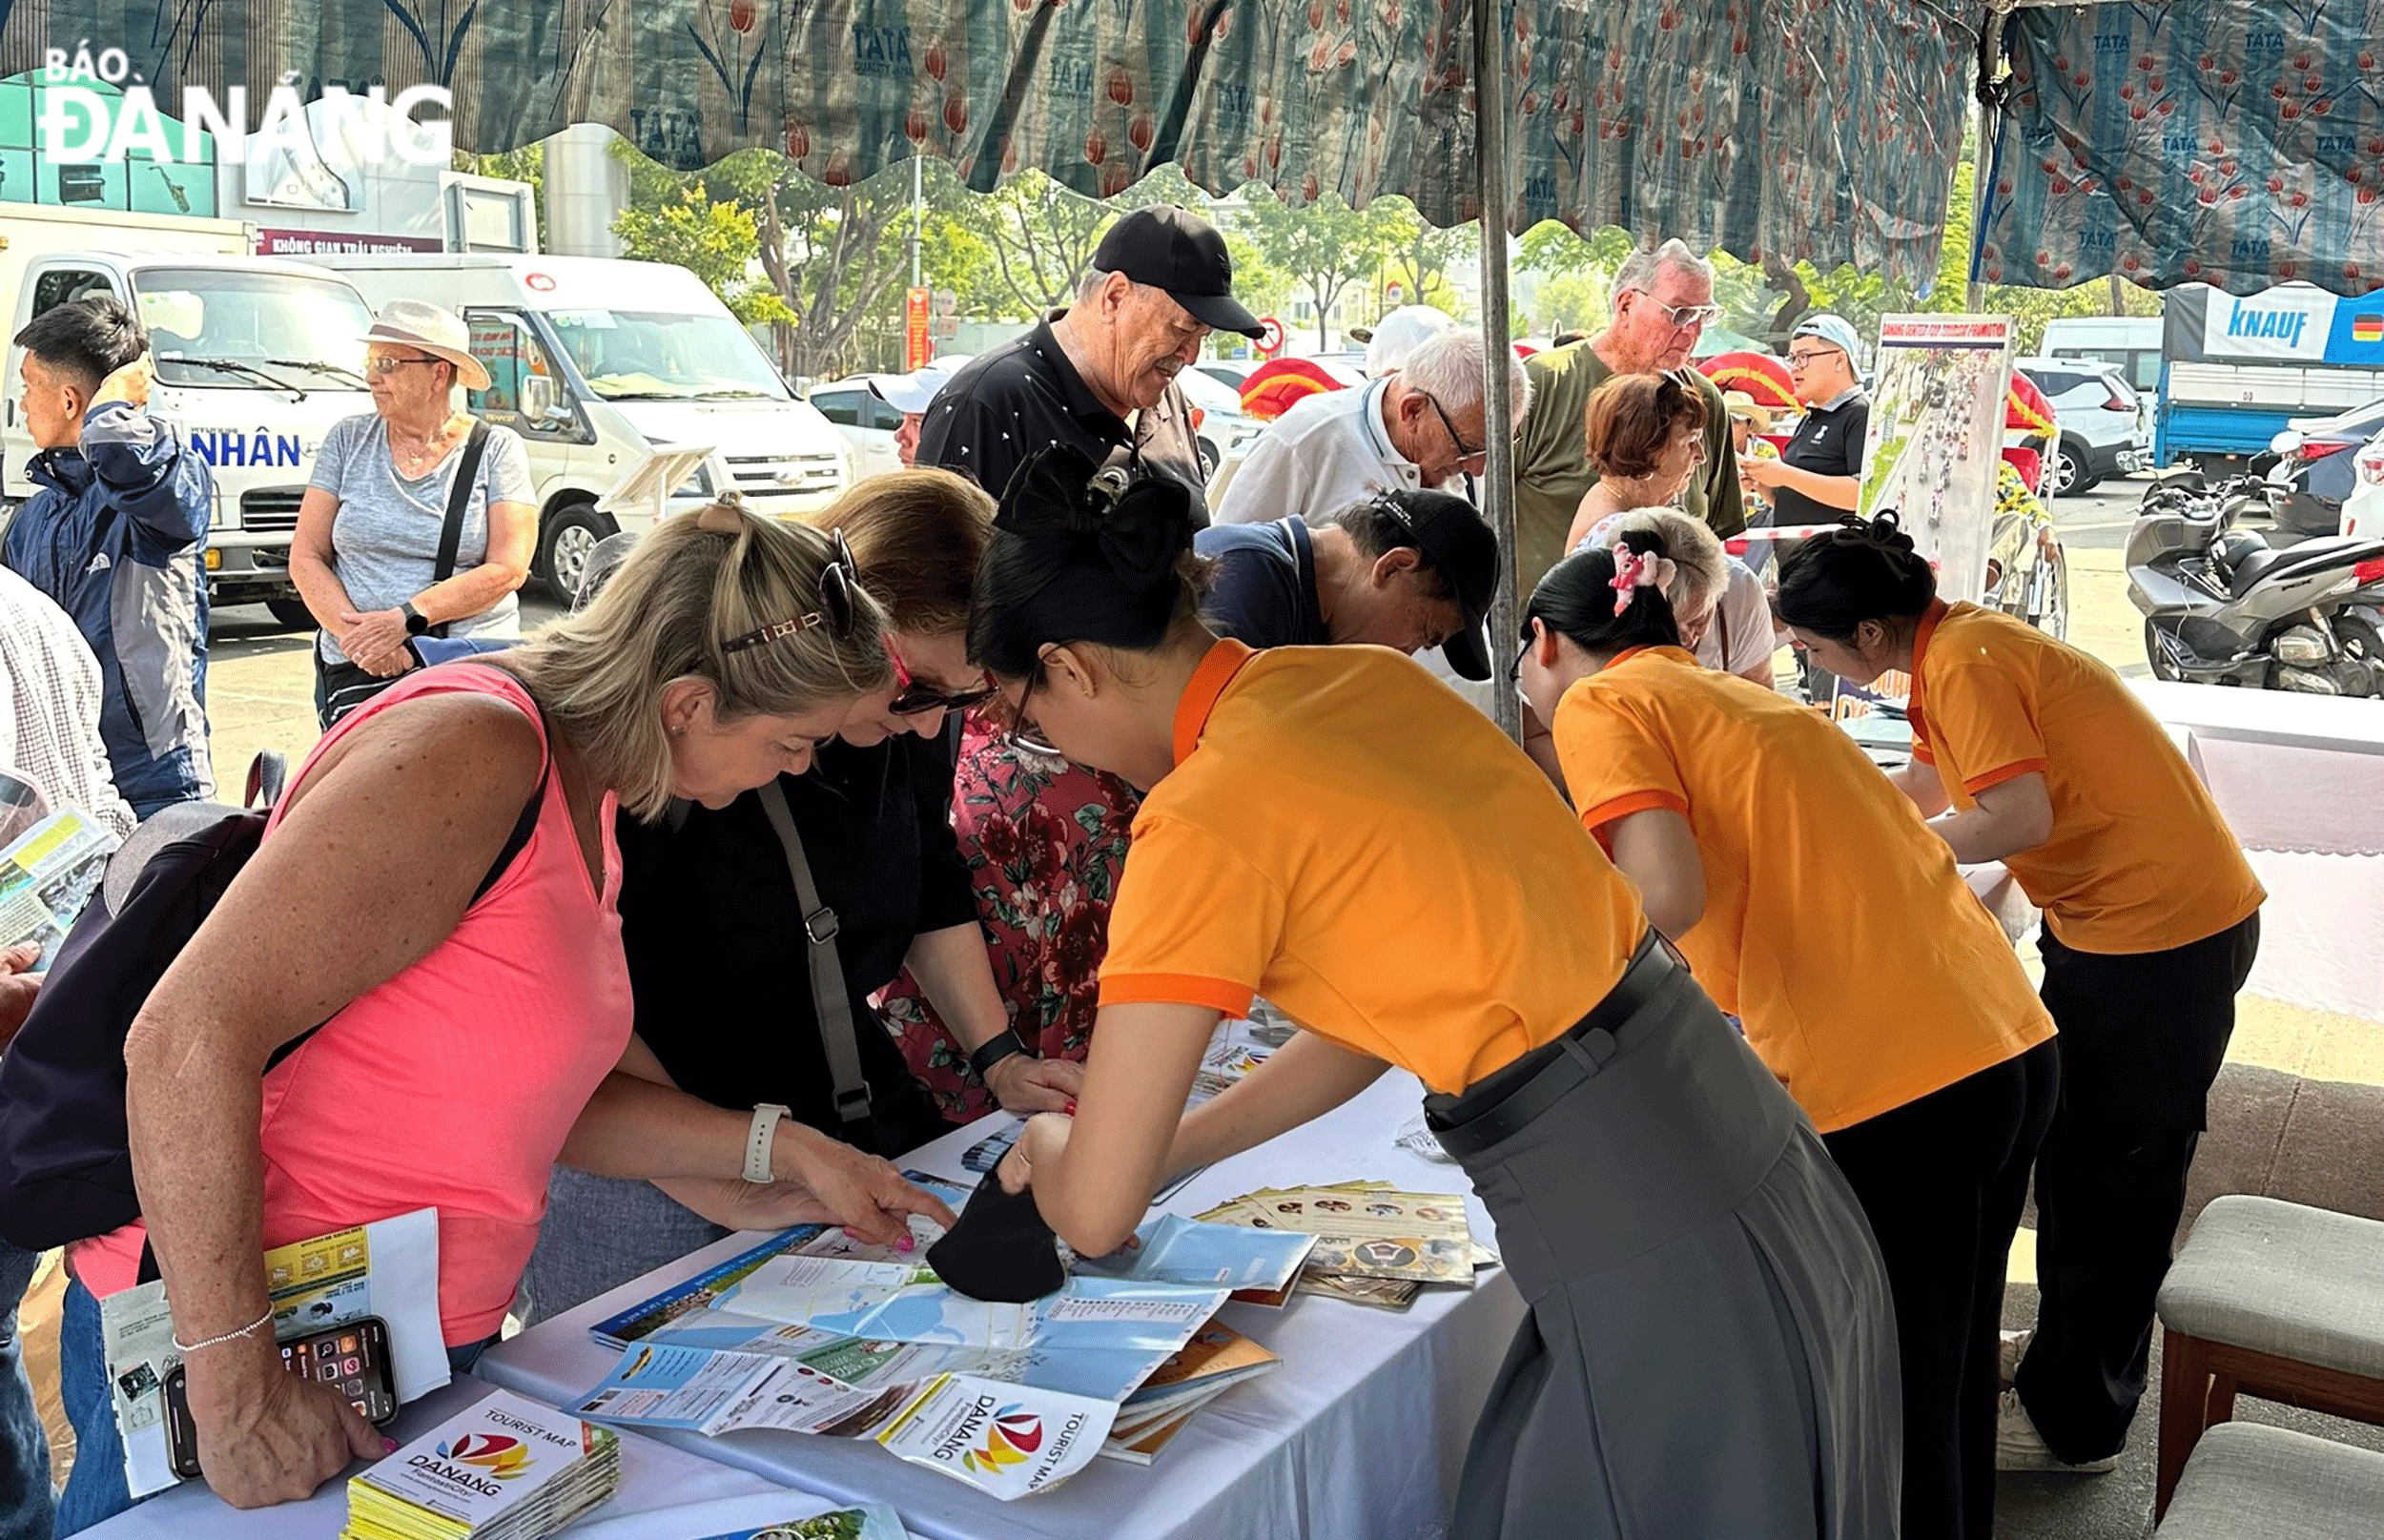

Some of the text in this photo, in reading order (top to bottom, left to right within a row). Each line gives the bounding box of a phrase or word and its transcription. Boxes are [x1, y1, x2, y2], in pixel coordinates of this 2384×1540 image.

[2093, 35, 2129, 49] TATA
[2245, 33, 2284, 49] TATA
[629, 109, 702, 153] TATA
[2163, 136, 2198, 151] TATA
[2315, 135, 2357, 152] TATA
[273, 236, 312, 253] KHÔNG
[314, 240, 341, 254] GIAN
[2079, 231, 2117, 247] TATA
[2230, 239, 2269, 256] TATA
[2228, 298, 2309, 348] KNAUF
[191, 425, 299, 466] NHÂN
[483, 1409, 545, 1437] TOURIST
[543, 1431, 577, 1448] MAP
[934, 1394, 997, 1461] DANANG
[1045, 1412, 1085, 1466] TOURIST
[407, 1454, 503, 1497] DANANG
